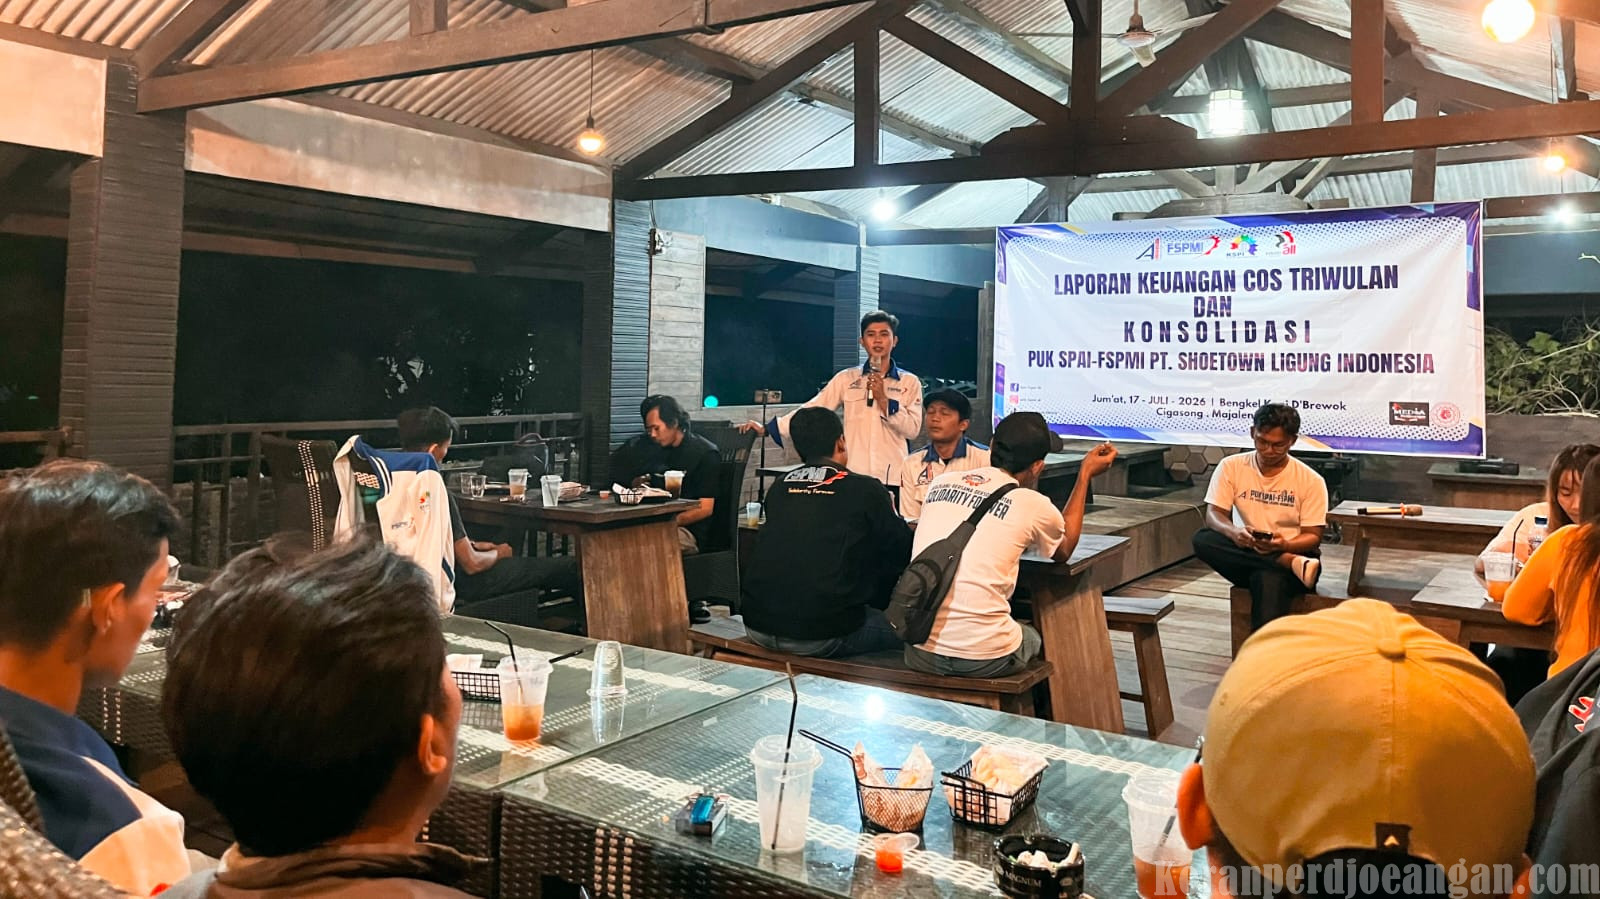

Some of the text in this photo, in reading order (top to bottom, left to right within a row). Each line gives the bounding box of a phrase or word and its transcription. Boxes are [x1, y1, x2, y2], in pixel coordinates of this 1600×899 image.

[1167, 242, 1204, 254] FSPMI
[1054, 265, 1398, 295] LAPORAN KEUANGAN COS TRIWULAN
[1193, 295, 1232, 318] DAN
[1124, 320, 1310, 343] KONSOLIDASI
[1028, 350, 1435, 374] PUK SPAI-FSPMI PT. SHOETOWN LIGUNG INDONESIA
[1092, 394, 1126, 404] Jum'at,
[1129, 395, 1140, 404] 17
[1148, 396, 1169, 405] JULI
[1178, 396, 1206, 406] 2026
[1219, 398, 1260, 409] Bengkel
[1291, 400, 1347, 411] D'Brewok
[1156, 407, 1204, 418] Cigasong
[1212, 409, 1254, 420] Majalen
